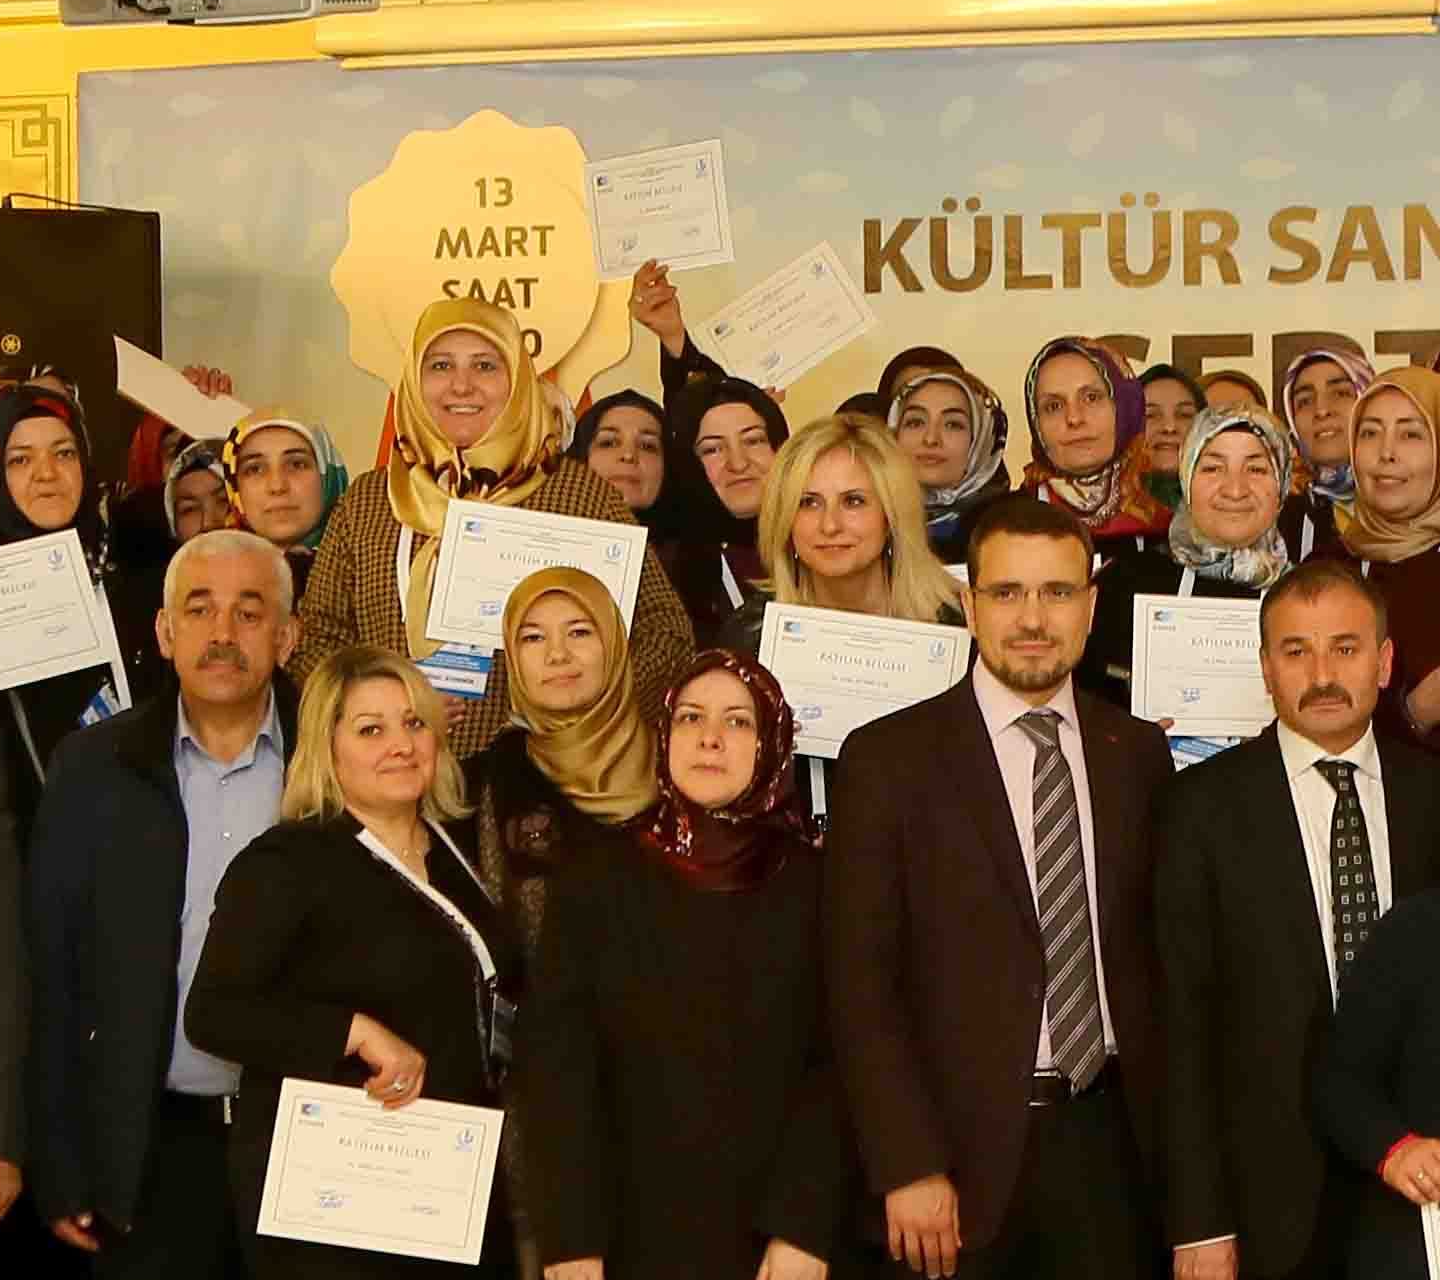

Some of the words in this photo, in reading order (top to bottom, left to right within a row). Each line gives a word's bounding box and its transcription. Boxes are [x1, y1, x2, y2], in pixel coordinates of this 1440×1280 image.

[474, 177, 514, 209] 13
[434, 224, 556, 260] MART
[862, 191, 1243, 295] KÜLTÜR
[442, 277, 539, 310] SAAT
